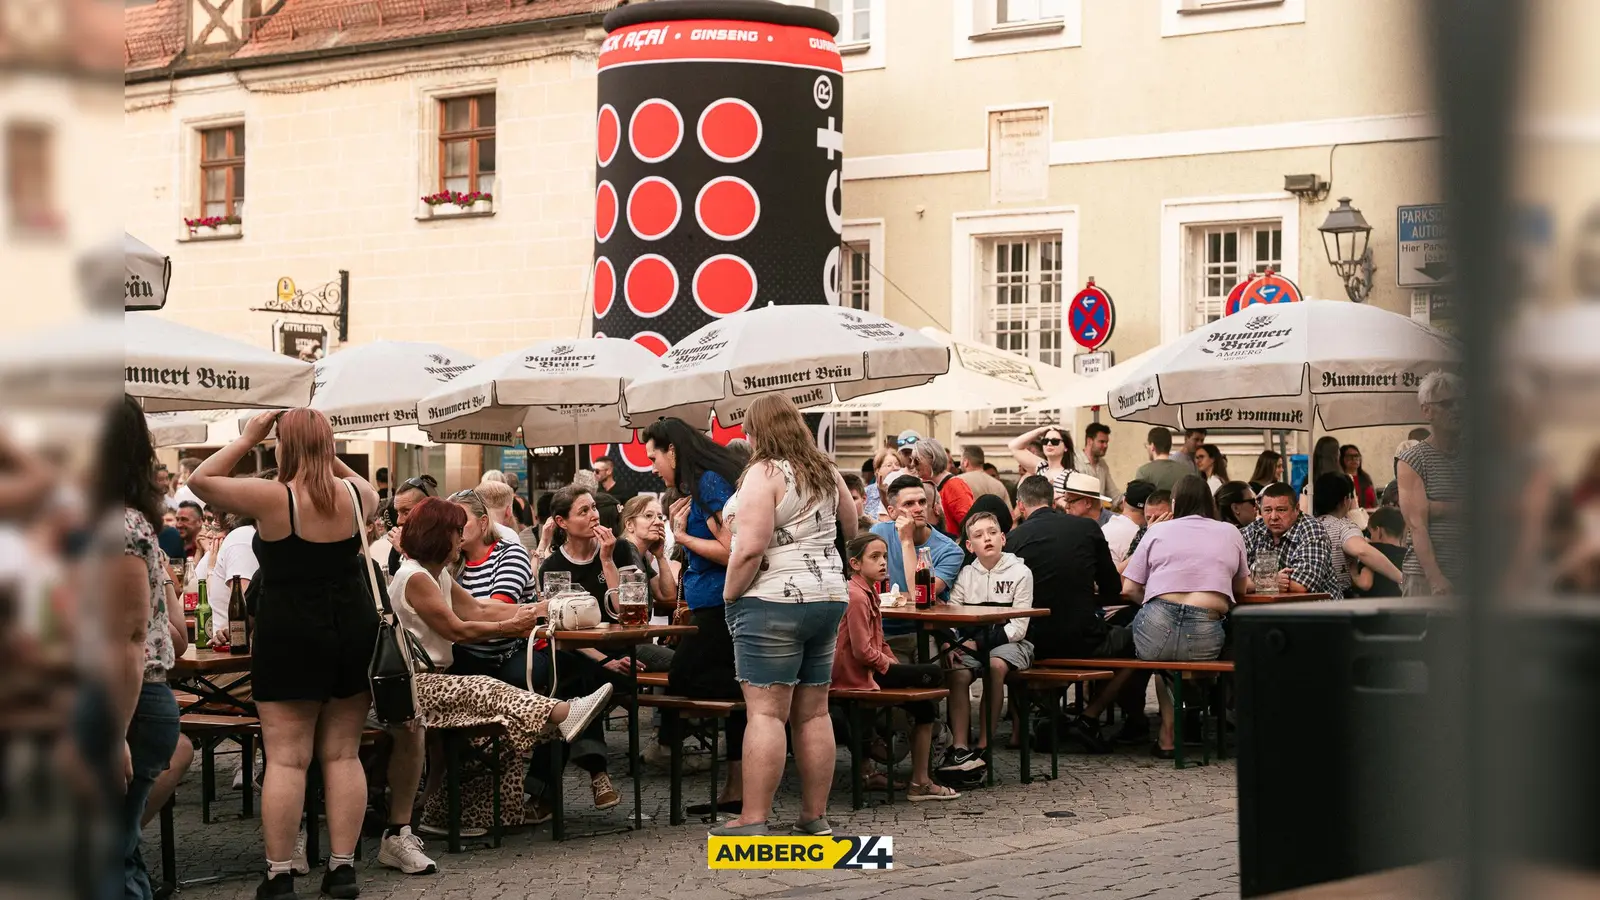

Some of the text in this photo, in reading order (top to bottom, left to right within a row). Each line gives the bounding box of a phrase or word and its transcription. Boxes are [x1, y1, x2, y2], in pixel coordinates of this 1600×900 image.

[622, 25, 669, 52] AÇAÍ
[690, 29, 758, 42] GINSENG
[1401, 244, 1420, 252] Hier
[1216, 349, 1263, 357] AMBERG
[196, 367, 250, 390] Bräu
[815, 365, 851, 380] Bräu
[995, 581, 1014, 593] NY
